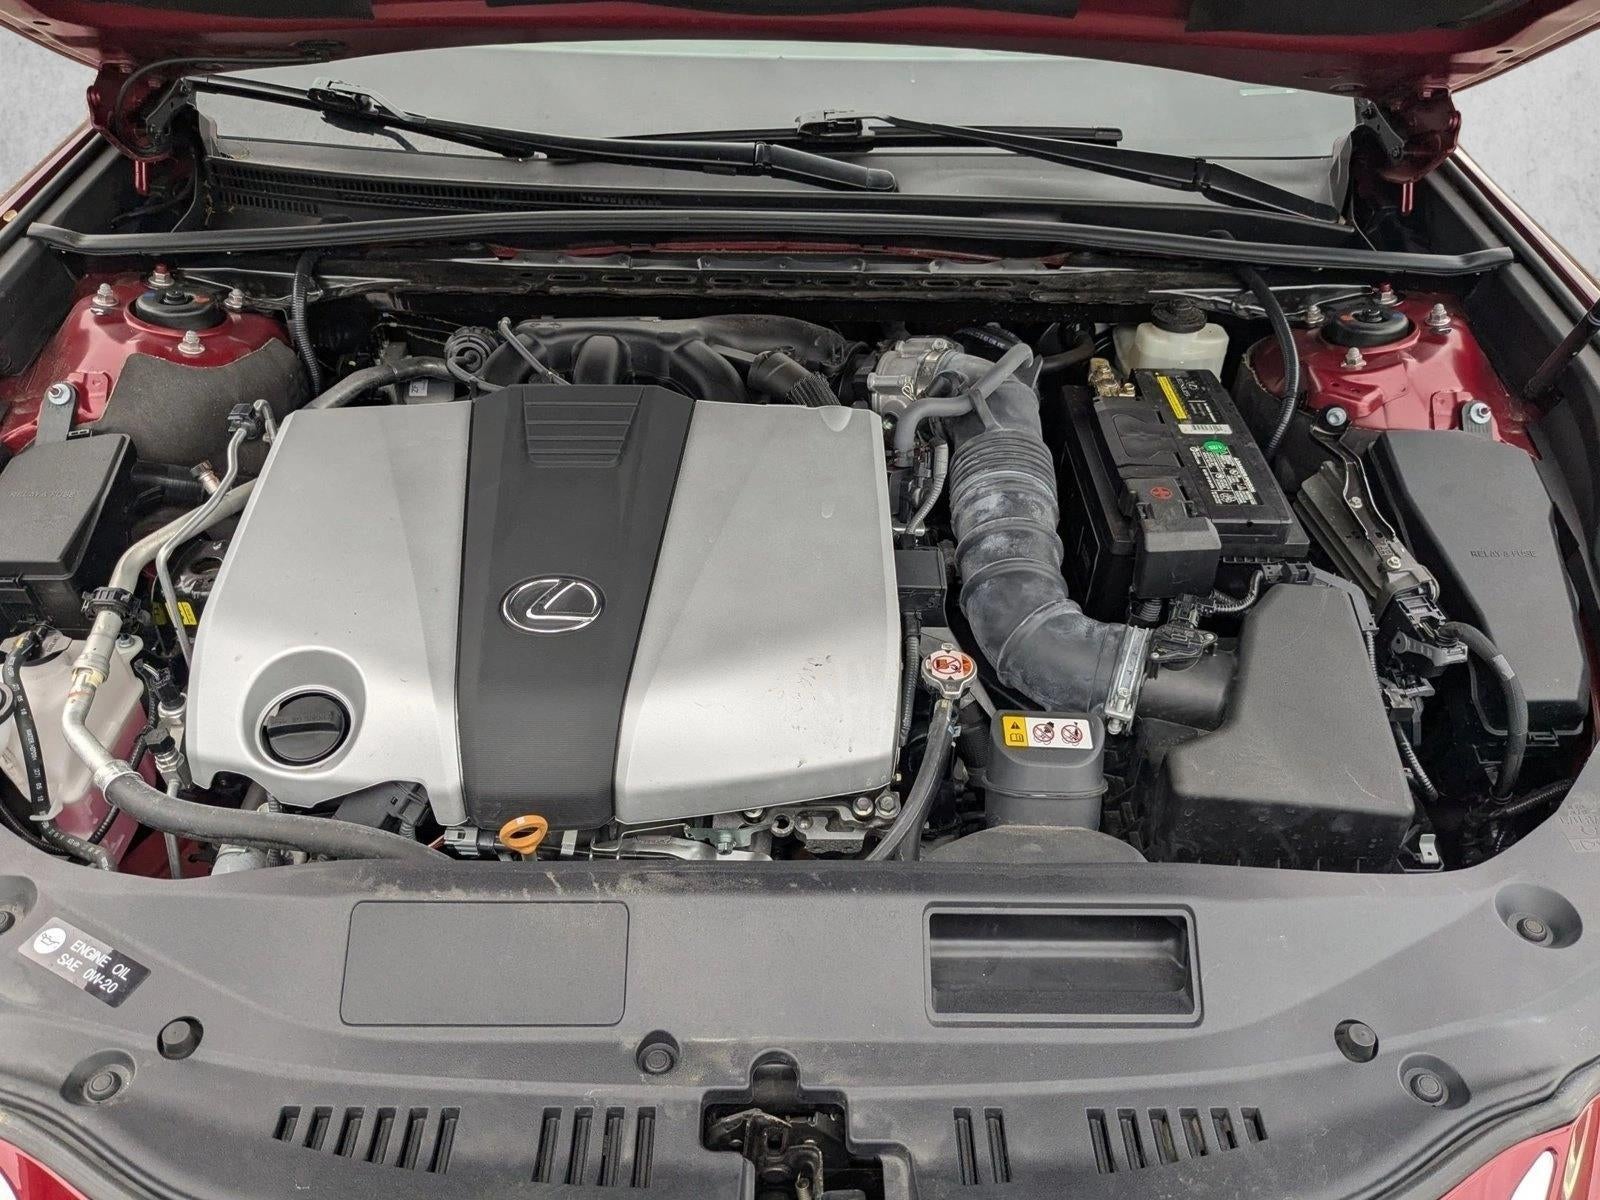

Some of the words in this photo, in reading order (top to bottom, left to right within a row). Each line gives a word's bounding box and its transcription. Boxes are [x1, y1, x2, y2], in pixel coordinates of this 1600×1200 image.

[1470, 550, 1500, 558] RELAY
[1512, 550, 1537, 558] FUSE
[57, 954, 82, 972] SAE
[83, 968, 118, 993] 0W-20
[70, 940, 112, 967] ENGINE
[111, 964, 132, 981] OIL
